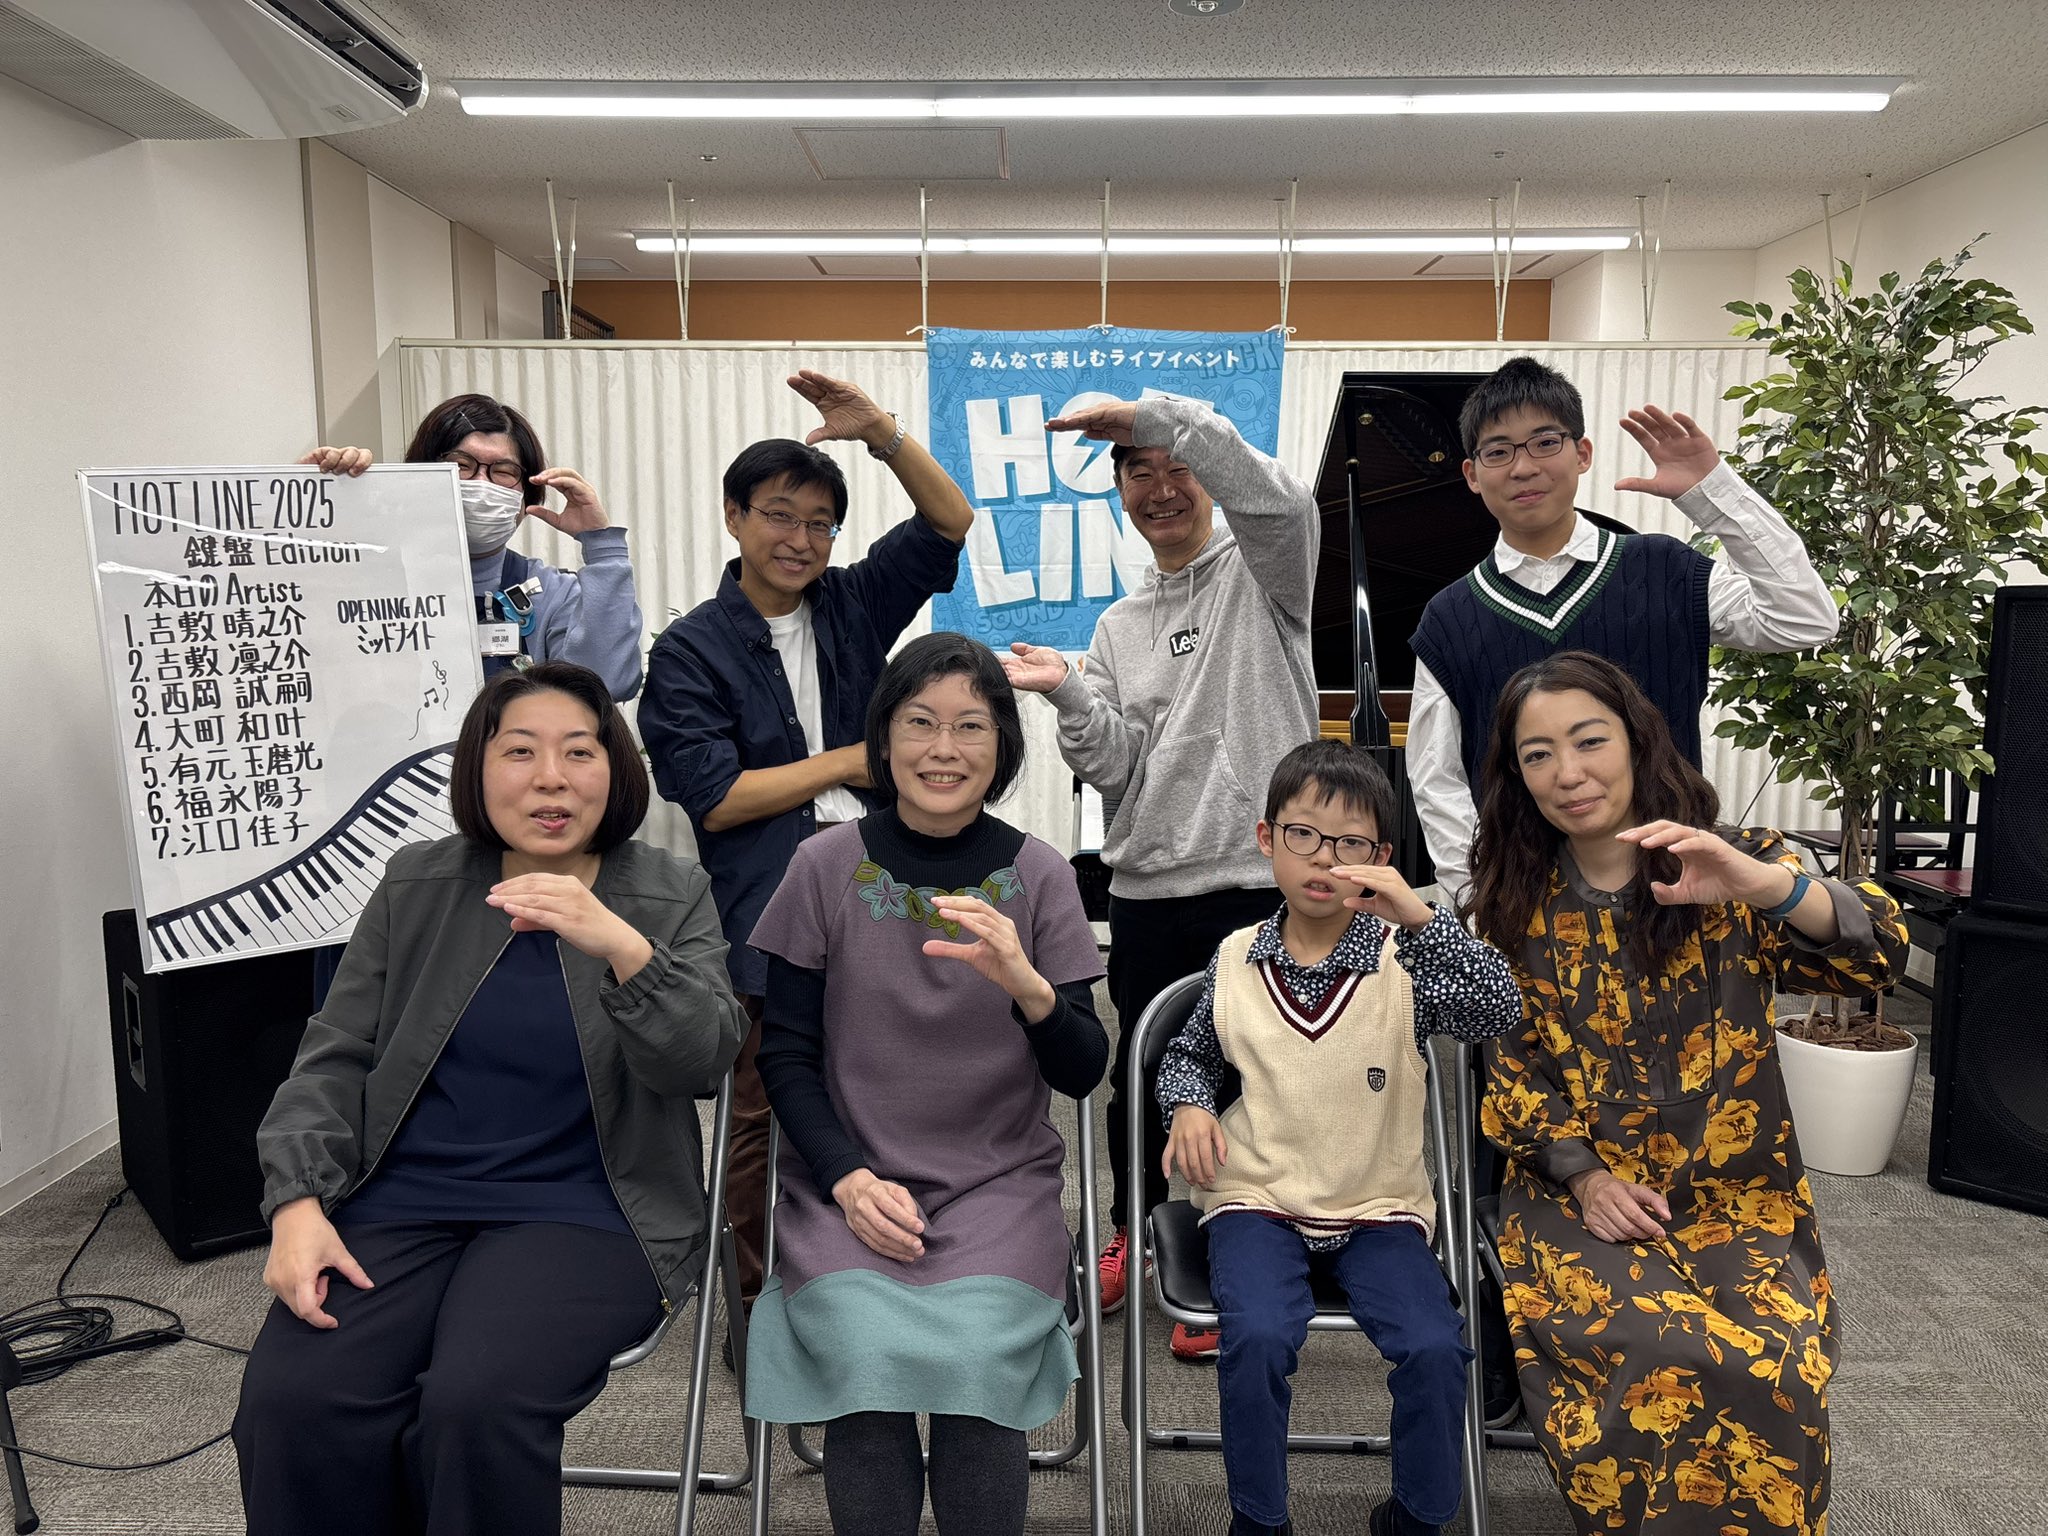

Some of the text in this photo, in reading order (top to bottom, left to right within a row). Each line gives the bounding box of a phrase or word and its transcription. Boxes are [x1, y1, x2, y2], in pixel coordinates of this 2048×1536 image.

[969, 349, 1240, 369] みんなで楽しむライブイベント
[965, 388, 1215, 499] HO
[113, 478, 335, 535] HOT LINE 2025
[184, 533, 361, 568] 鍵盤 Edition
[965, 499, 1226, 607] LIN
[225, 572, 303, 606] Artist
[337, 594, 447, 624] OPENING ACT
[974, 602, 1065, 634] SOUND
[357, 620, 437, 655] ミッドナイト
[1170, 634, 1198, 654] Lee
